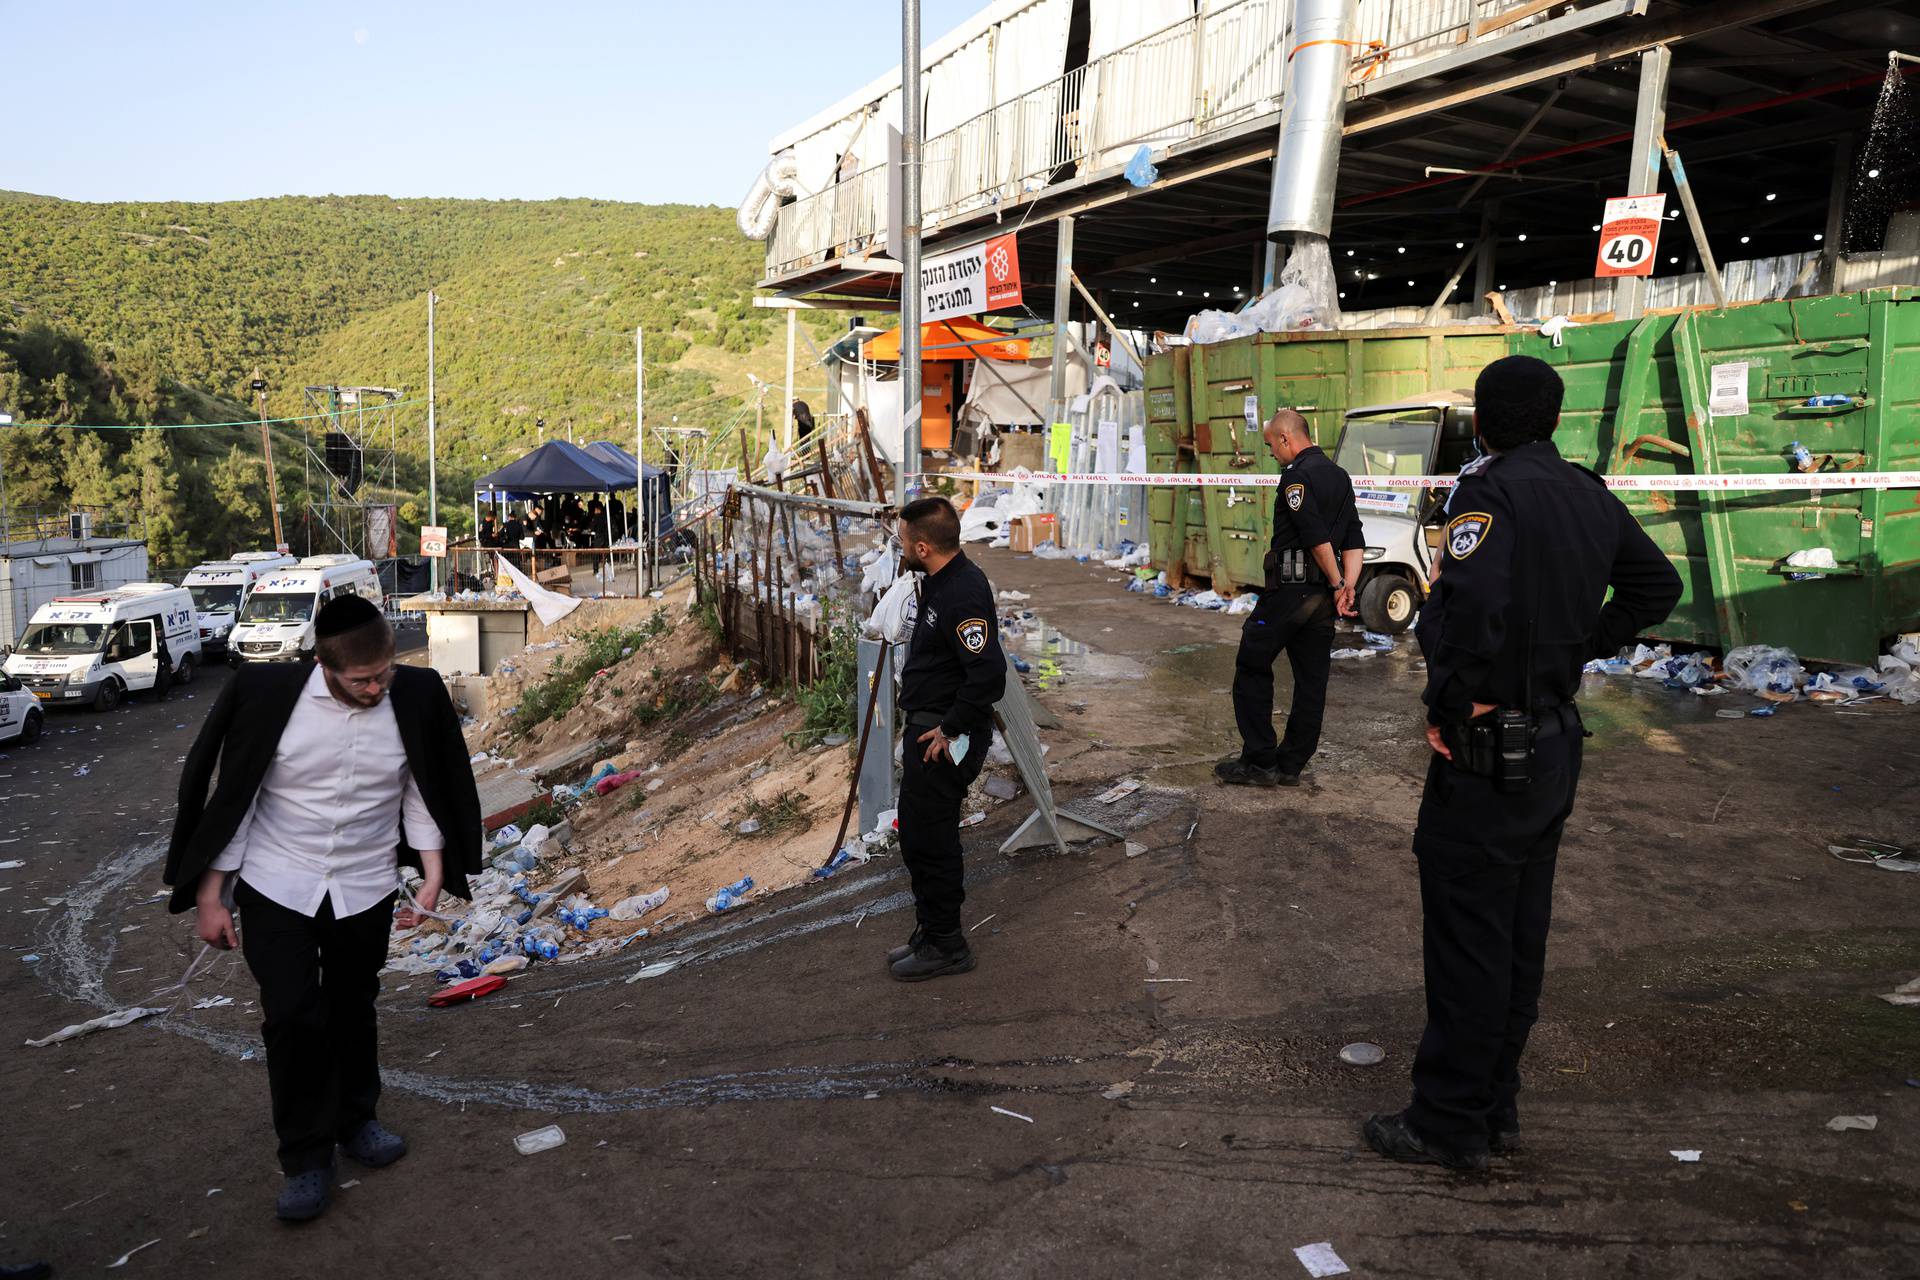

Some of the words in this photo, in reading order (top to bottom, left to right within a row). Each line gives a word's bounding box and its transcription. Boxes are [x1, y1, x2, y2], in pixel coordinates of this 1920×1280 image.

[1607, 238, 1644, 263] 40
[920, 265, 945, 291] הזנק
[948, 256, 982, 280] נקודת
[928, 287, 972, 313] מתנדבים
[1695, 479, 1719, 487] ישראל
[1746, 478, 1767, 486] מעבר
[1822, 478, 1847, 486] ישראל
[1873, 477, 1891, 485] מעבר
[426, 542, 441, 551] 43
[92, 663, 101, 672] 31
